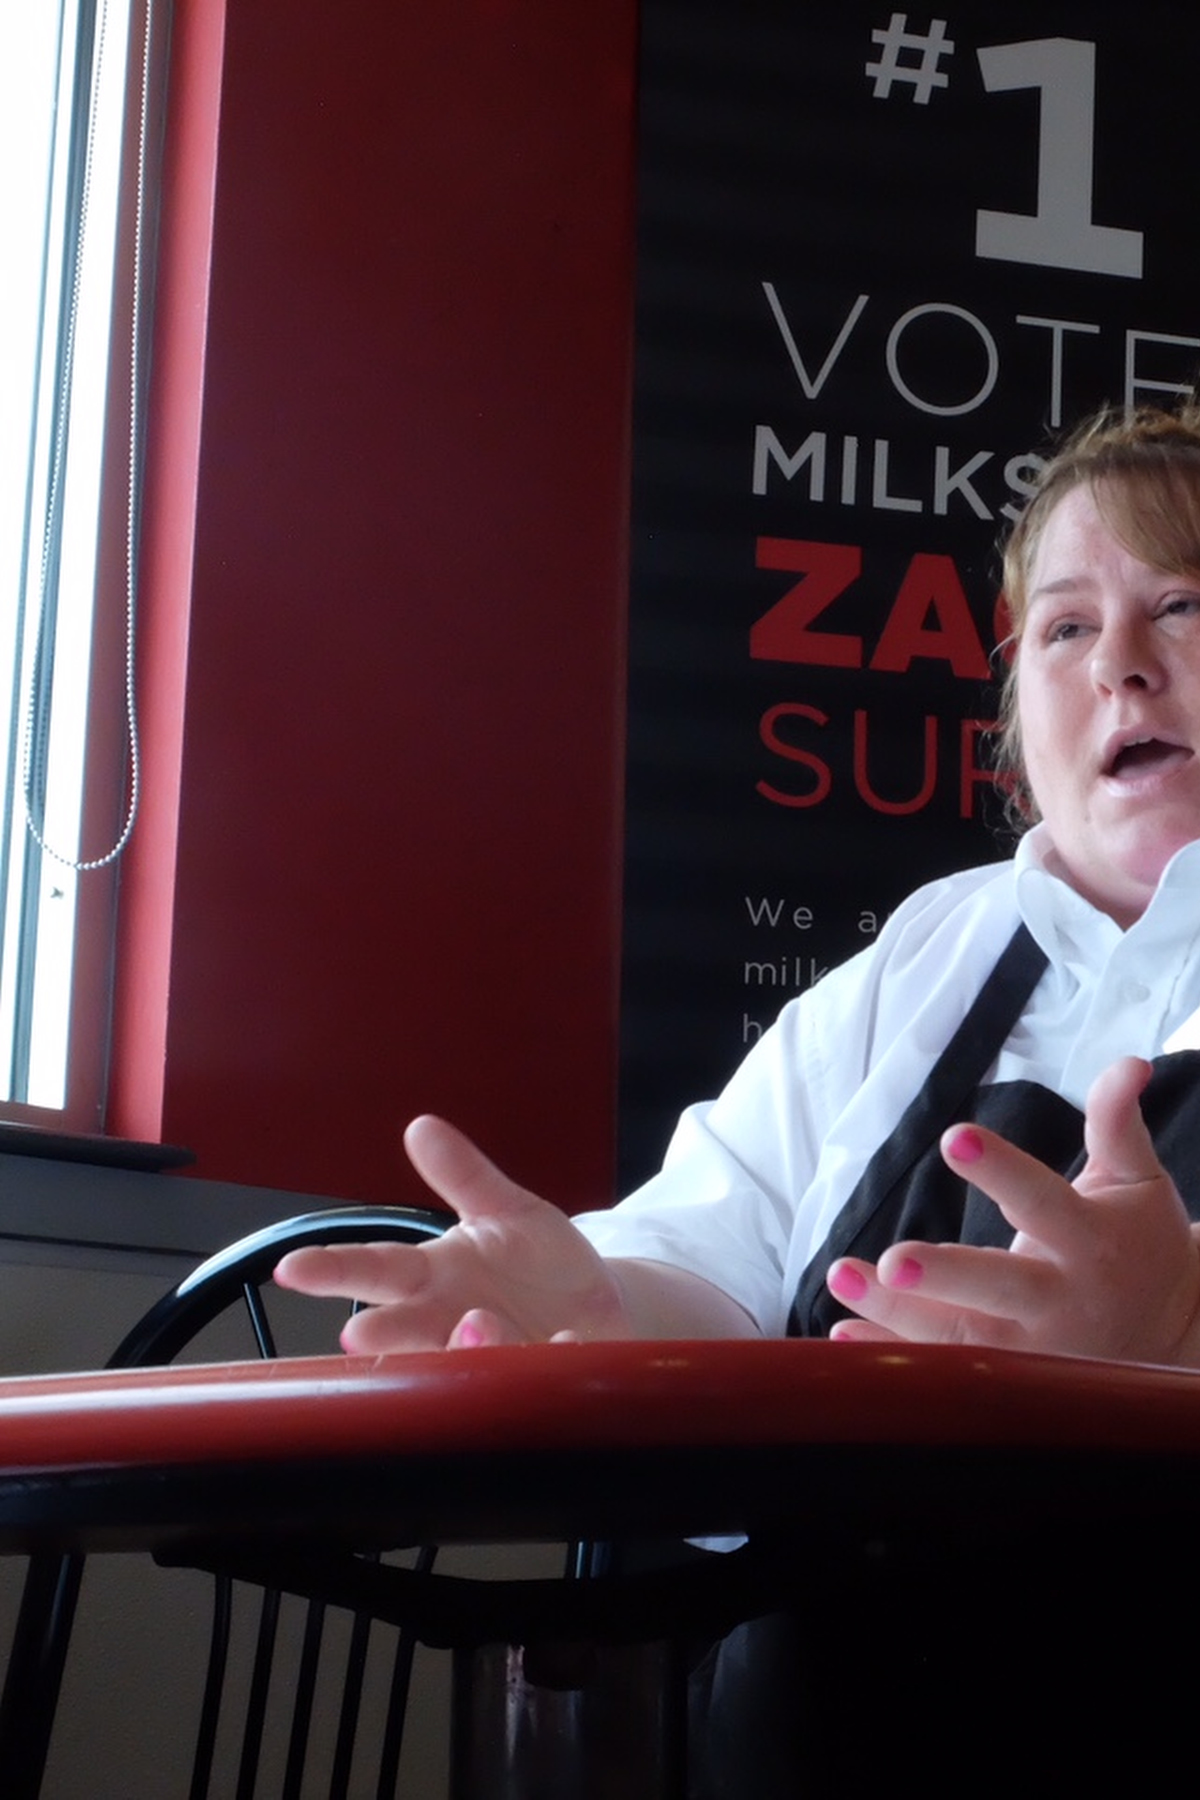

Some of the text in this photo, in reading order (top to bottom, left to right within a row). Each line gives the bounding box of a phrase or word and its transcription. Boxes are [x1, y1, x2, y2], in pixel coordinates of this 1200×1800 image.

[865, 12, 1144, 279] #1
[752, 425, 1046, 522] MILKS
[750, 536, 1018, 680] ZA
[755, 702, 1034, 822] SUR
[745, 896, 894, 934] We a
[744, 956, 829, 987] milk
